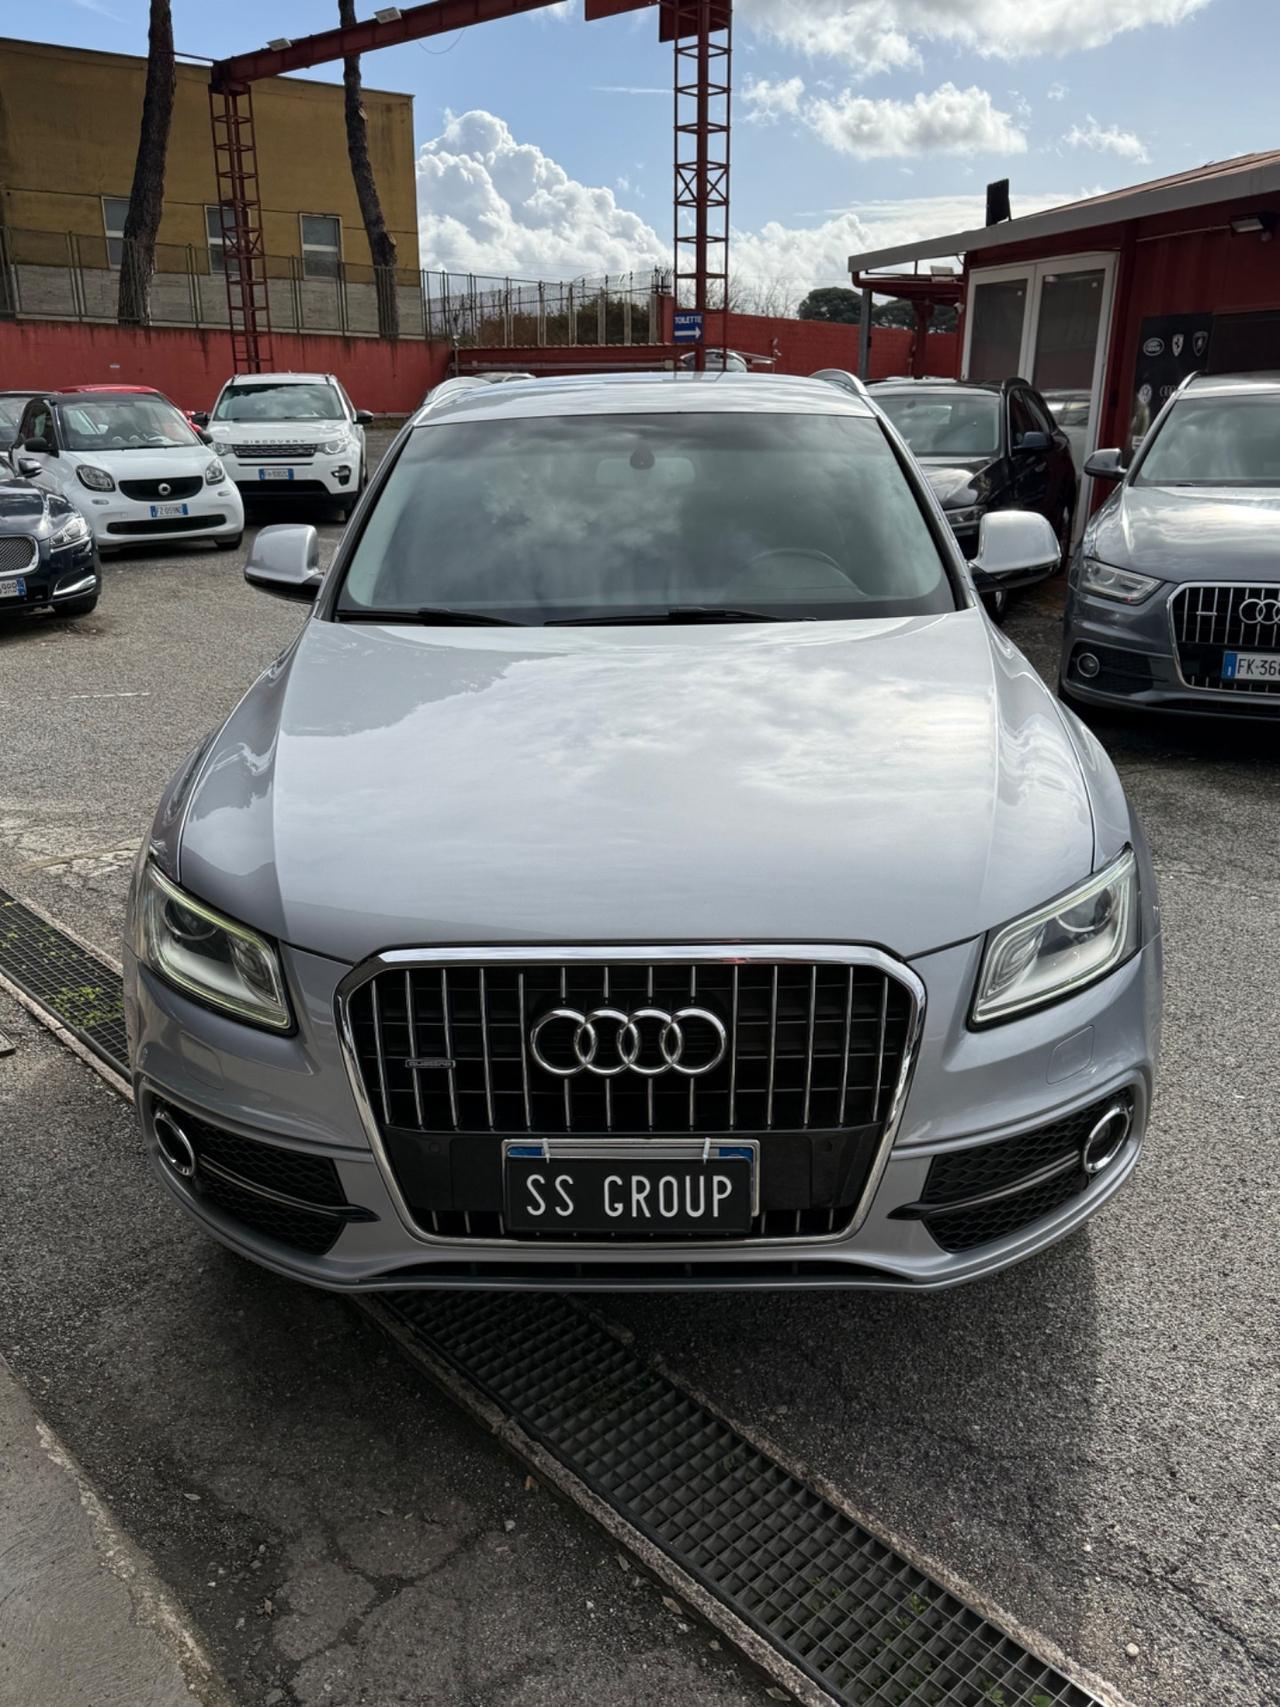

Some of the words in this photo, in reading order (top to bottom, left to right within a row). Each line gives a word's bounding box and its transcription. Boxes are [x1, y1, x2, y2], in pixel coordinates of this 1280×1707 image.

[1237, 658, 1255, 675] FK
[526, 1174, 574, 1216] SS
[603, 1175, 733, 1218] GROUP
